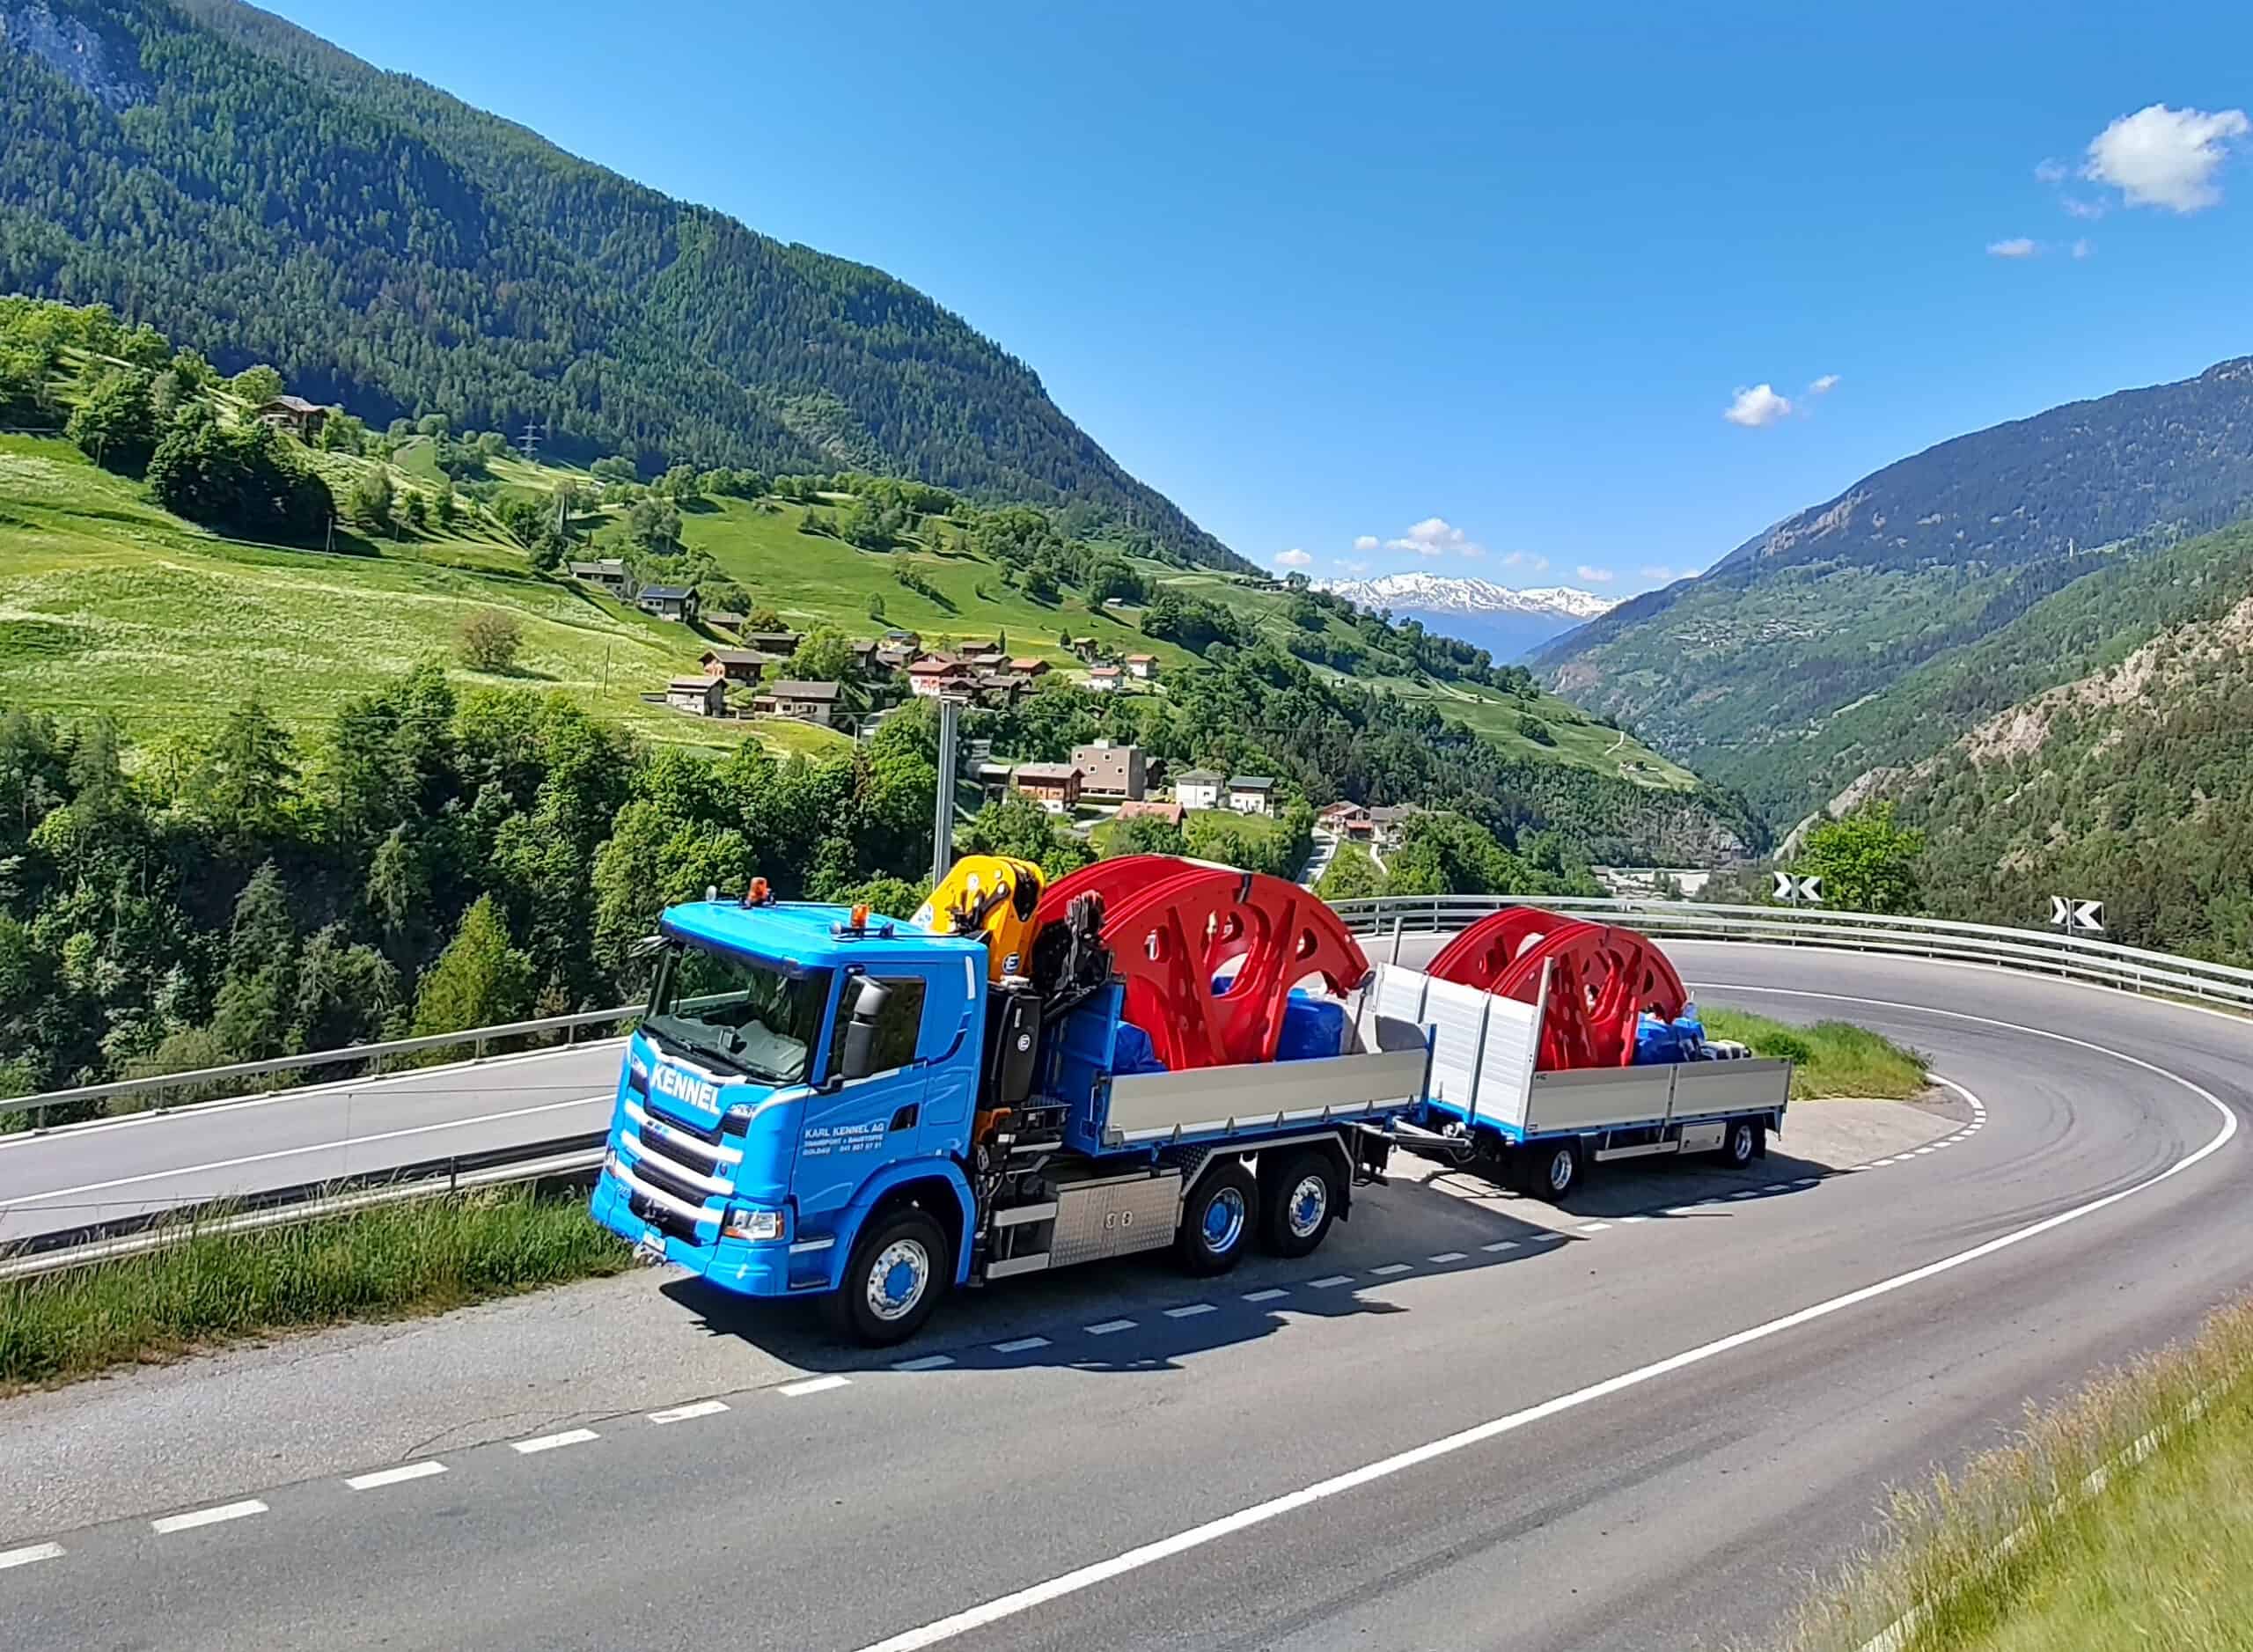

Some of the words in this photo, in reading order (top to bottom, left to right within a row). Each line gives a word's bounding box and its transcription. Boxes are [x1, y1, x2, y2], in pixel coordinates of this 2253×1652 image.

[651, 1062, 721, 1115] KENNEL
[804, 1128, 831, 1139] KARL
[833, 1126, 870, 1137] KENNEL
[871, 1122, 884, 1133] AG
